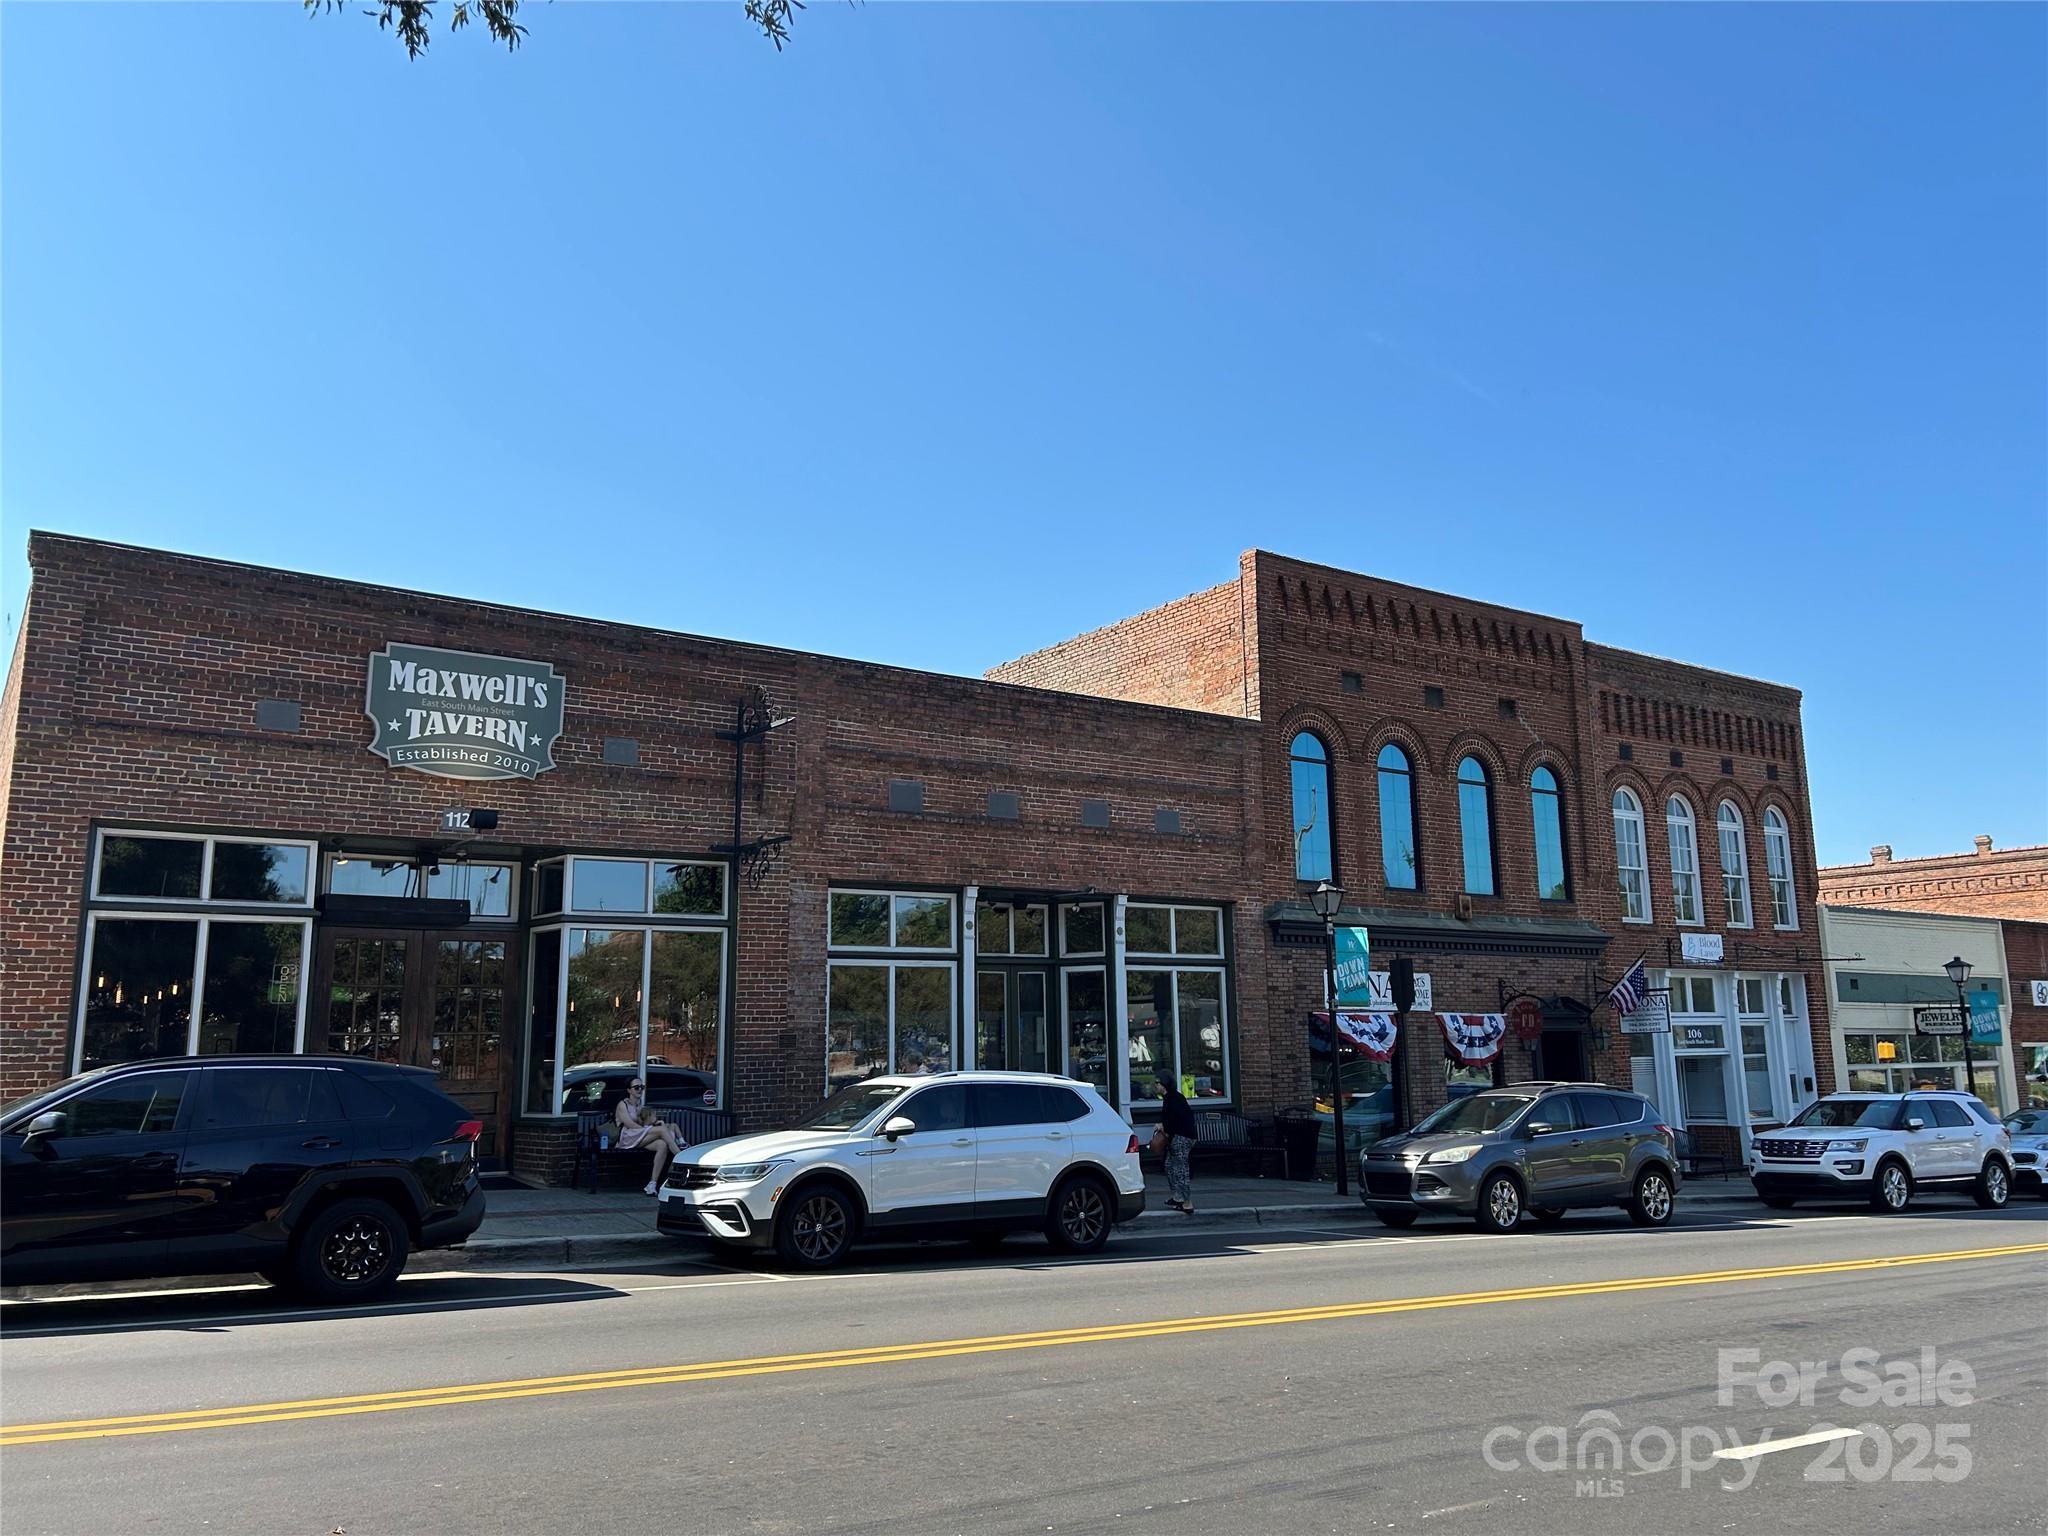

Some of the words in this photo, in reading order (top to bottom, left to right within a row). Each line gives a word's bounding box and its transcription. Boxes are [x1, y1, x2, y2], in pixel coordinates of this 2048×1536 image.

[388, 659, 548, 708] Maxwell's
[421, 698, 439, 708] East
[441, 700, 466, 711] South
[467, 703, 489, 713] Main
[490, 705, 516, 716] Street
[406, 708, 528, 752] TAVERN
[396, 748, 489, 763] Established
[494, 755, 530, 773] 2010
[445, 812, 470, 828] 112
[1337, 957, 1365, 978] DOWN
[279, 966, 290, 1002] OPEN
[1340, 971, 1367, 990] TOWN
[1414, 988, 1430, 999] OME
[1920, 1012, 1960, 1022] JEWELR
[1972, 1010, 1997, 1026] DOWN
[1687, 1029, 1702, 1039] 106
[1975, 1020, 2000, 1033] TOWN
